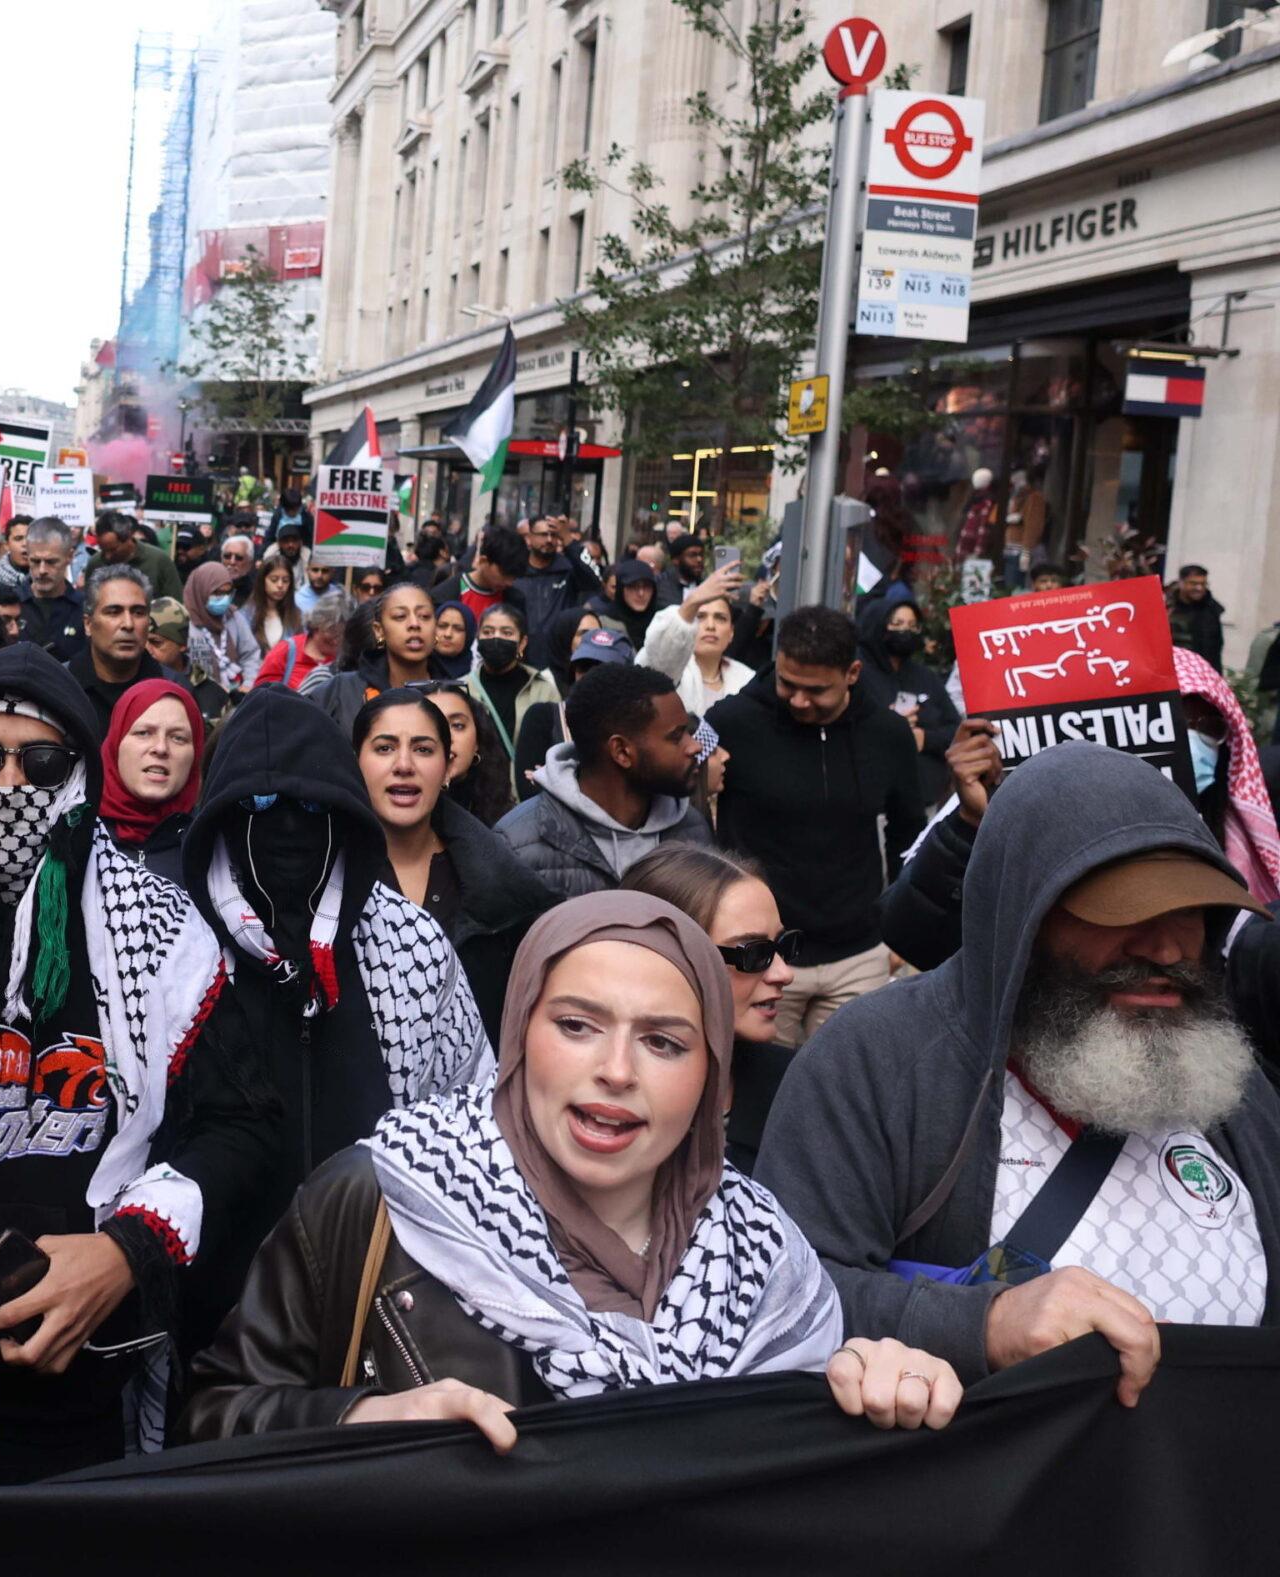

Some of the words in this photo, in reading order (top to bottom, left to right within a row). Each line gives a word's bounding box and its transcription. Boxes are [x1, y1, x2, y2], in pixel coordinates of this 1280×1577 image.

[839, 27, 879, 77] V
[904, 131, 927, 144] BUS
[927, 133, 957, 148] STOP
[894, 206, 918, 218] Beak
[921, 208, 951, 221] Street
[1003, 198, 1138, 259] HILFIGER
[878, 246, 918, 256] towards
[922, 249, 962, 262] Aldwych
[868, 278, 891, 290] 139
[904, 280, 932, 294] N15
[941, 283, 966, 297] N18
[860, 311, 895, 325] N113
[167, 482, 192, 493] FREE
[329, 468, 383, 492] FREE
[40, 487, 88, 495] Palestinian
[151, 492, 205, 504] PALESTINE
[53, 501, 76, 509] Lives
[320, 492, 388, 509] PALESTINE
[978, 601, 1135, 660] لفلسطين
[1004, 647, 1131, 697] الحرية
[990, 701, 1175, 760] PALESTIN
